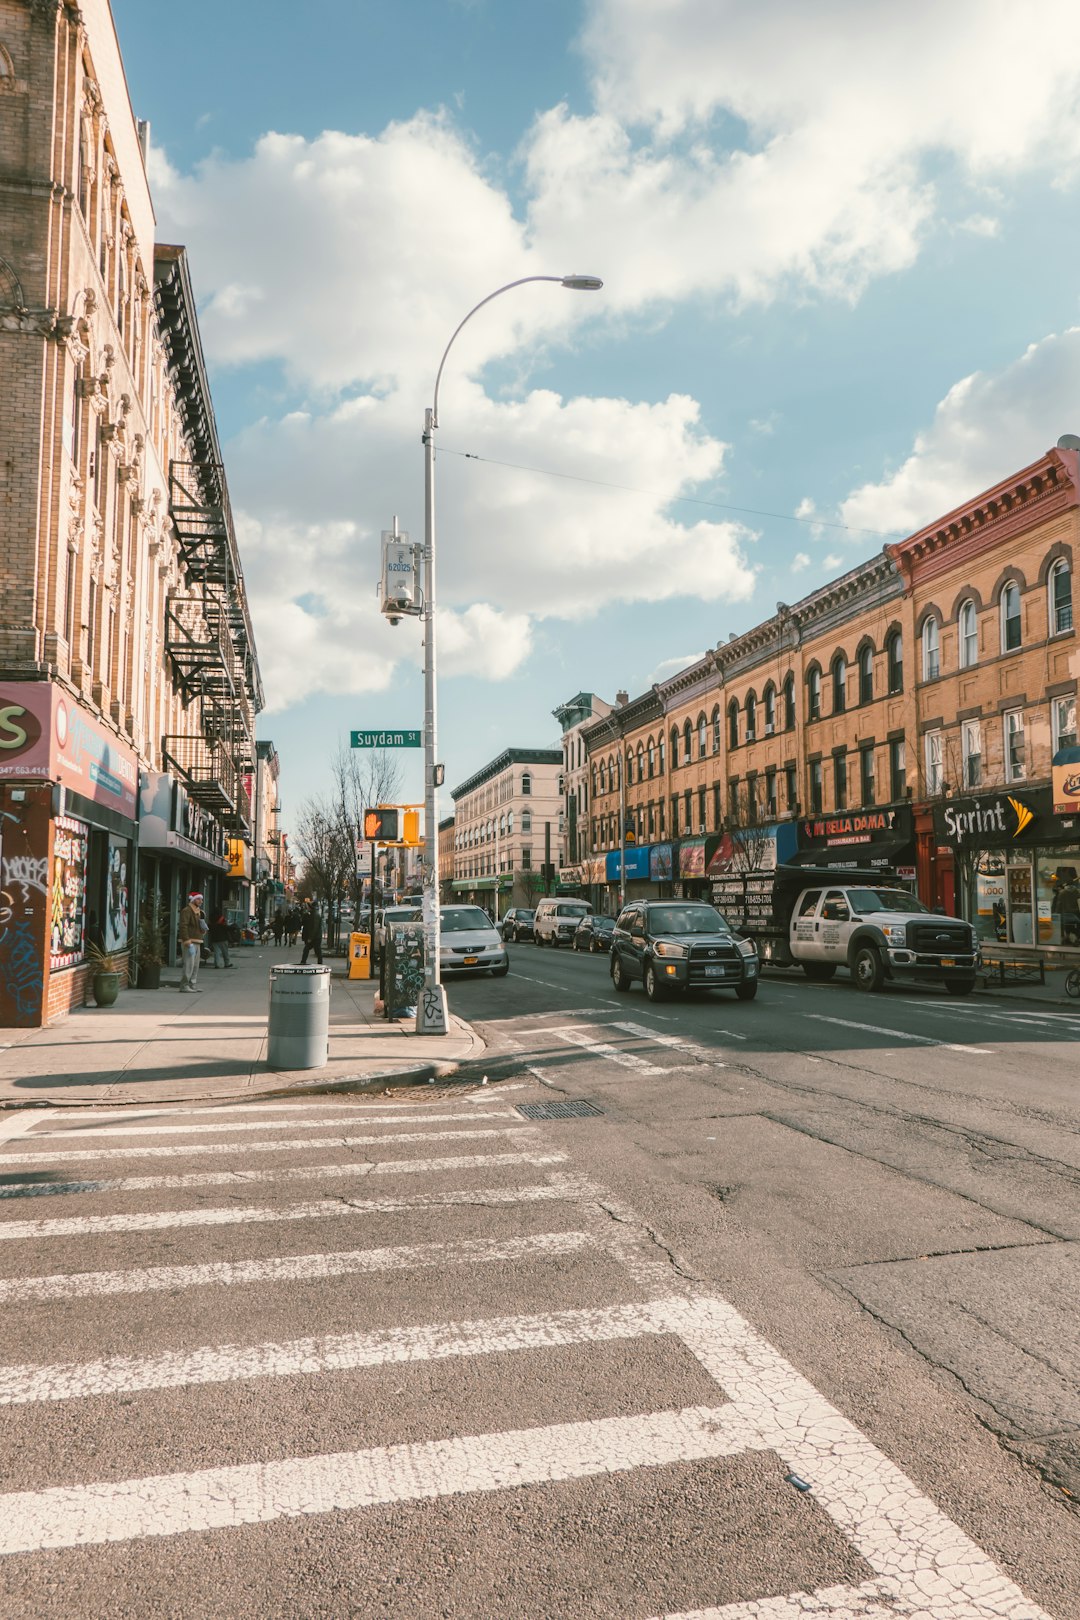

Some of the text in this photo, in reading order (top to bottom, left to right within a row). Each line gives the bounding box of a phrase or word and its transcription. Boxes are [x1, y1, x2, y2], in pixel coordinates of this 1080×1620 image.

[357, 732, 416, 748] Suydam St
[826, 818, 852, 834] BELLA
[853, 813, 886, 831] DAMA
[944, 801, 1007, 844] Sprint
[828, 836, 855, 846] RESTAURANT
[860, 835, 870, 843] BAR
[898, 867, 915, 875] ATM
